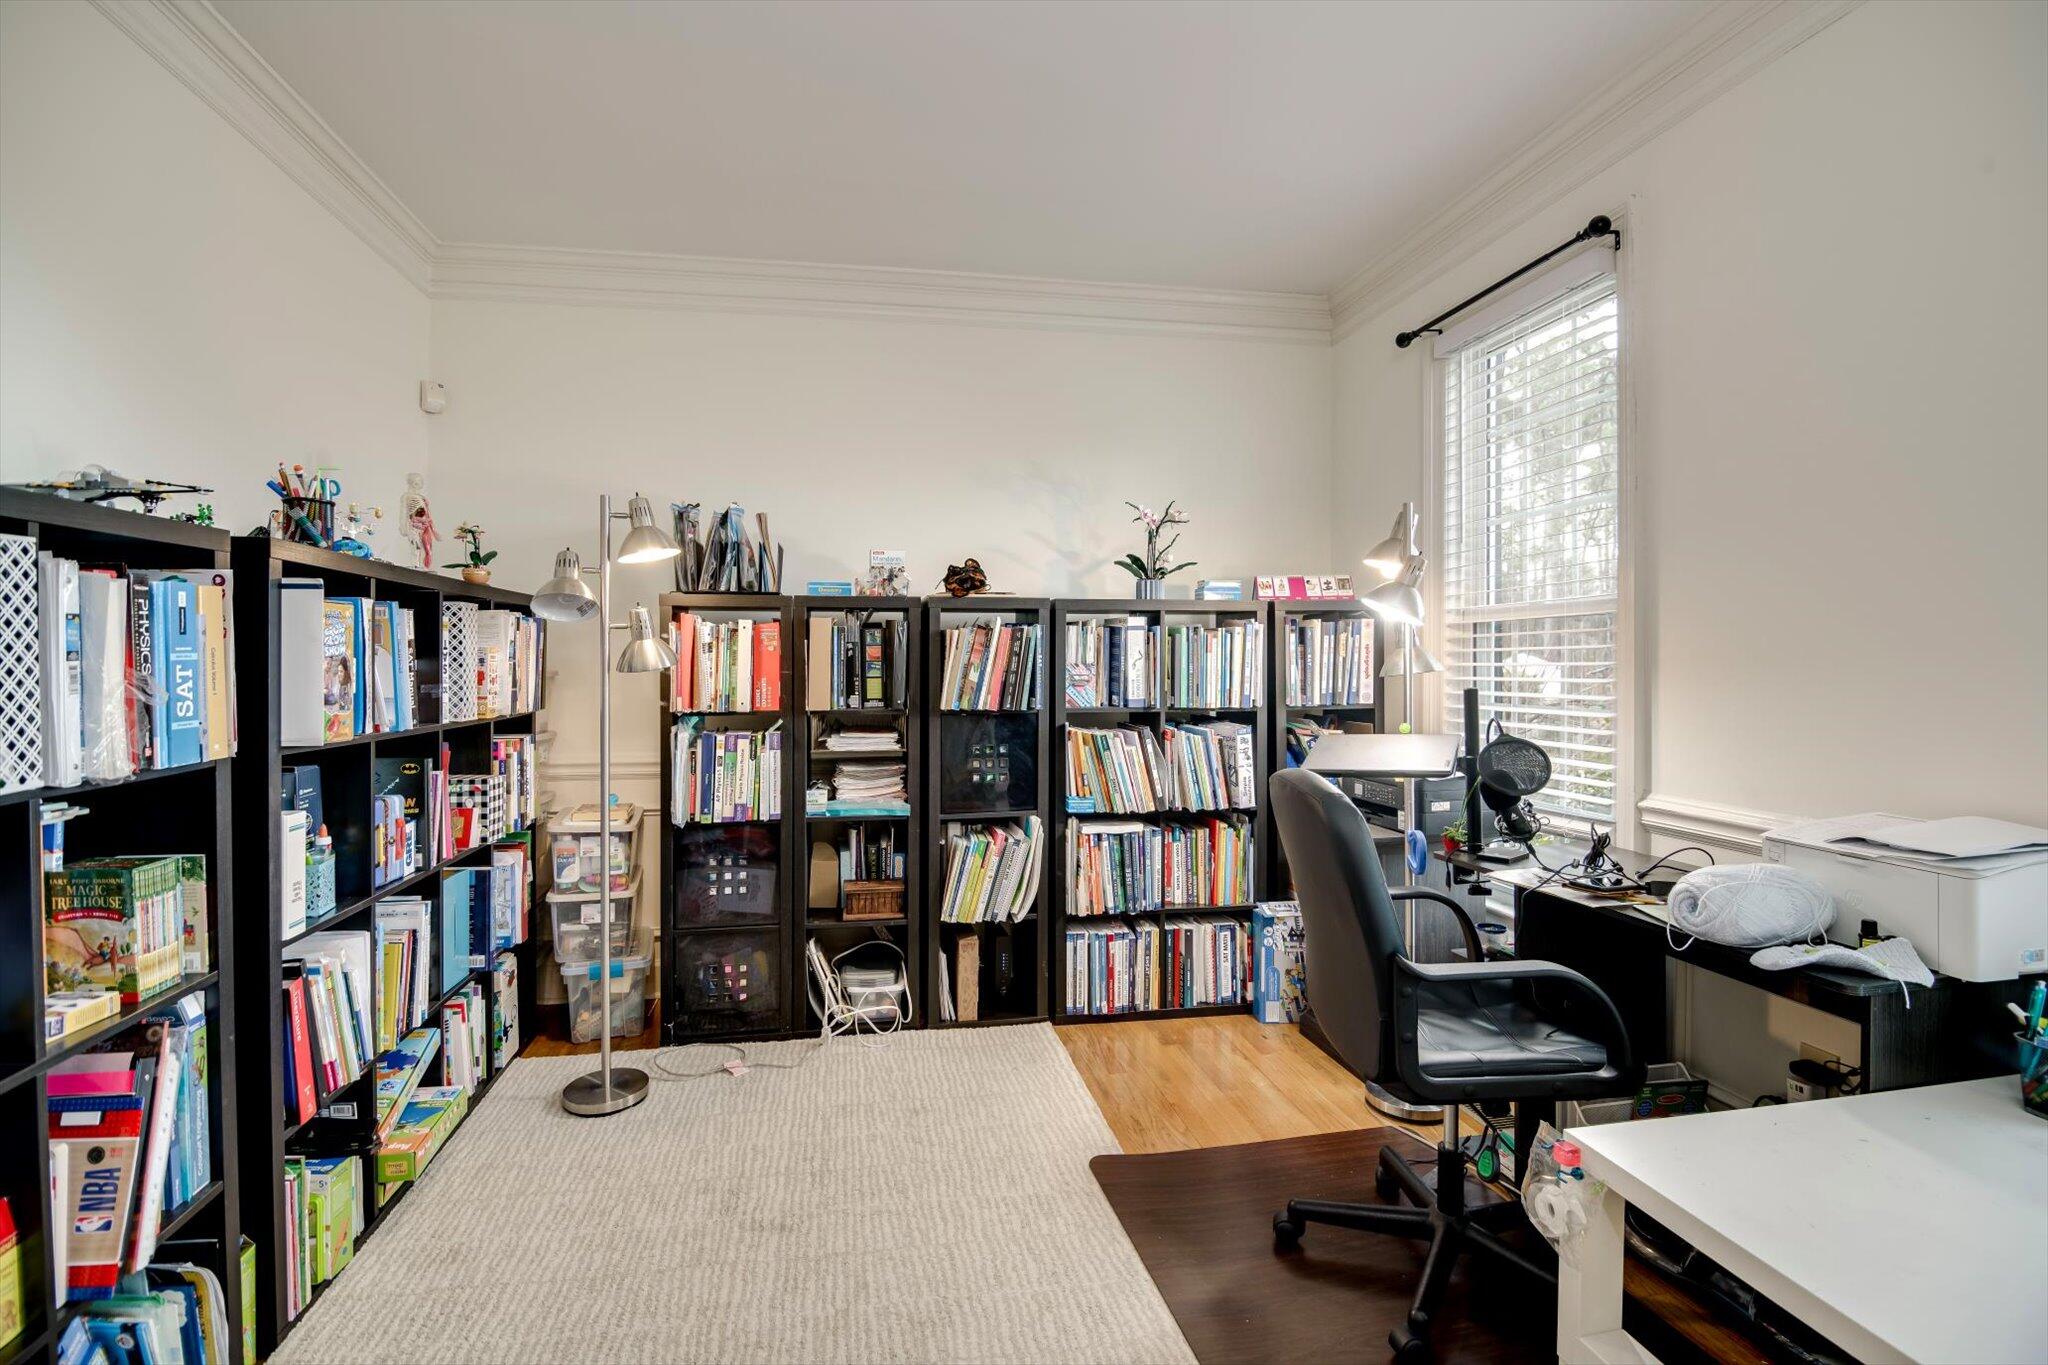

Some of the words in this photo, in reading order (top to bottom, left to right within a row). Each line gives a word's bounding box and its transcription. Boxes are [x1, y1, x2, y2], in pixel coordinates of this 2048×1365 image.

[138, 598, 152, 677] PHYSICS
[176, 664, 194, 718] SAT
[51, 896, 80, 911] TREE
[83, 896, 124, 910] HOUSE
[66, 884, 108, 896] MAGIC
[292, 991, 303, 1042] Literature
[78, 1166, 122, 1213] NBA
